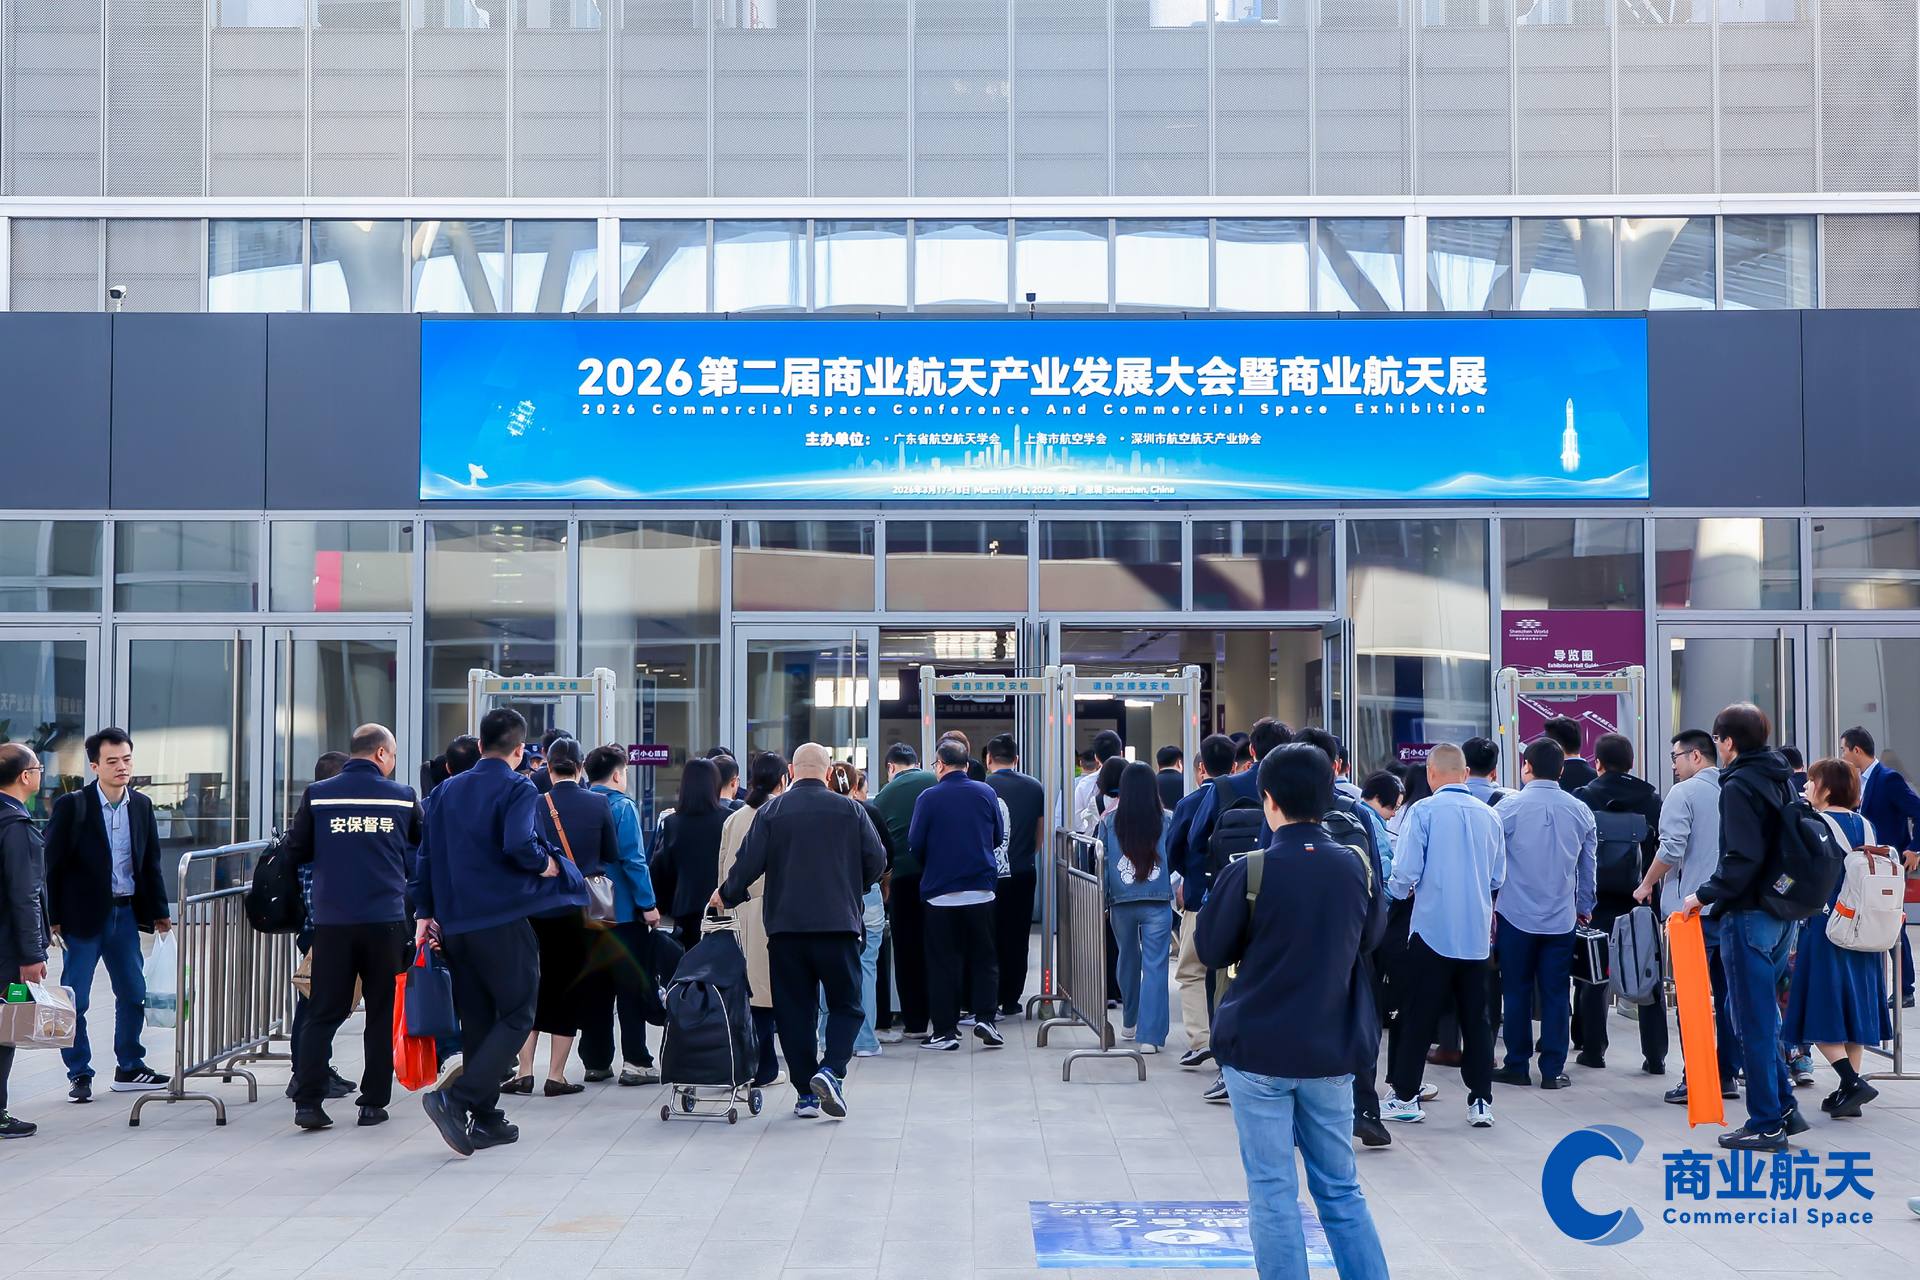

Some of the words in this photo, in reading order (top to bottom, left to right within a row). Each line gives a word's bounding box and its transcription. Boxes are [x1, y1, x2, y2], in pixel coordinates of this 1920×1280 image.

[578, 355, 1488, 397] 2026第二届商业航天产业发展大会暨商业航天展
[582, 403, 635, 415] 2026
[652, 403, 794, 415] Commercial
[809, 403, 876, 417] Space
[893, 403, 1029, 415] Conference
[1046, 403, 1086, 415] And
[1103, 403, 1243, 415] Commercial
[1260, 403, 1328, 417] Space
[1355, 402, 1485, 414] Exhibition
[1553, 649, 1594, 661] 导览图
[330, 816, 395, 834] 安保督导
